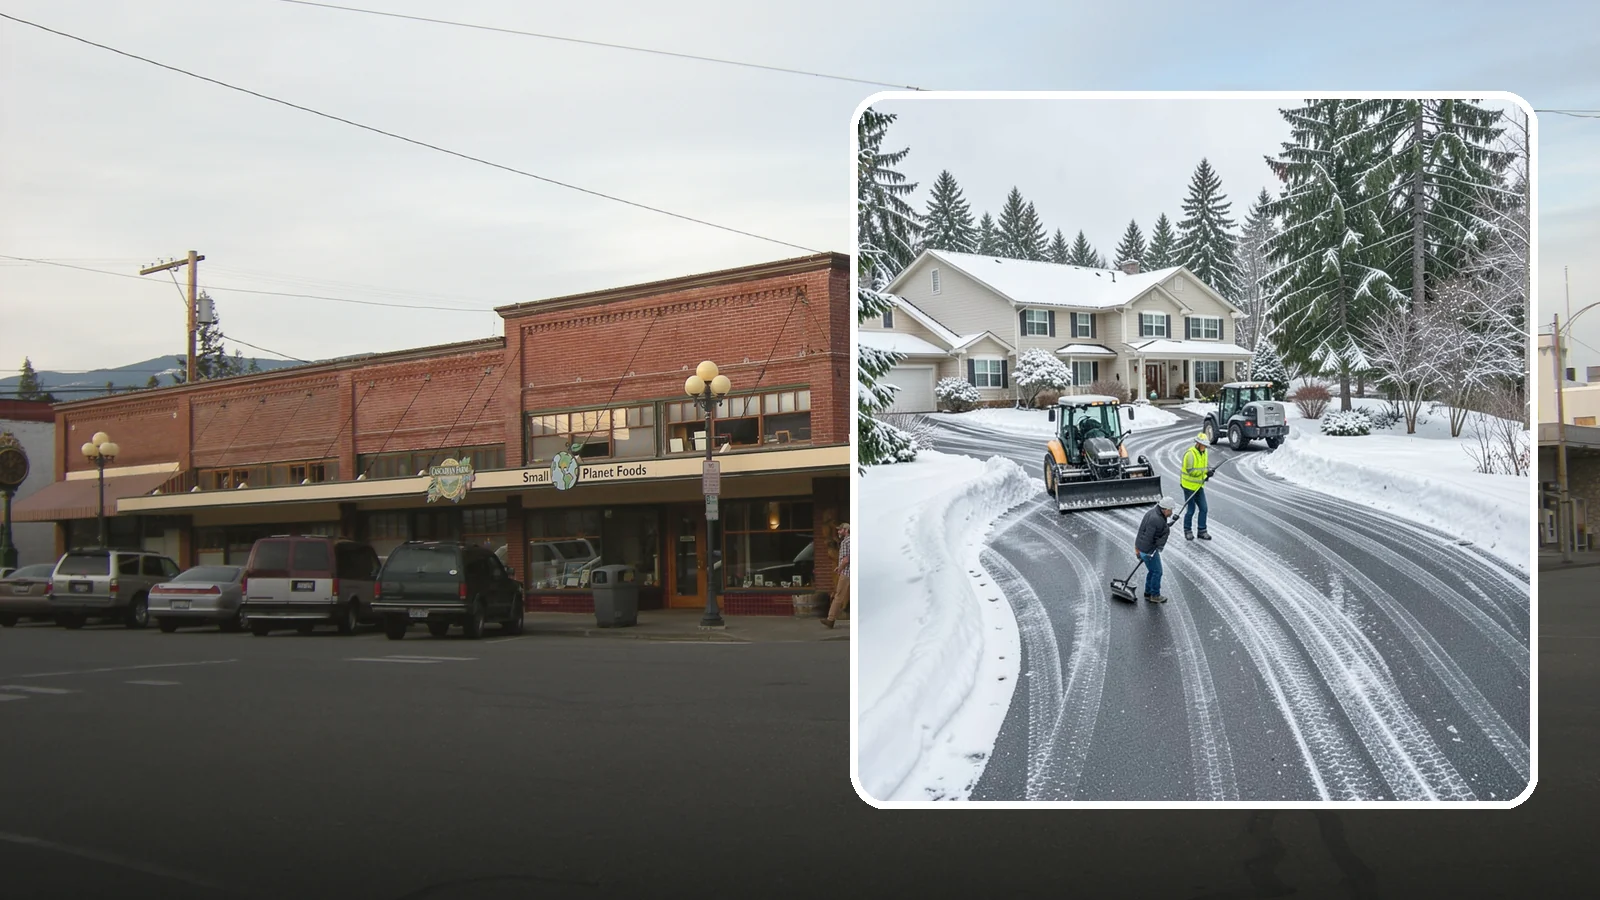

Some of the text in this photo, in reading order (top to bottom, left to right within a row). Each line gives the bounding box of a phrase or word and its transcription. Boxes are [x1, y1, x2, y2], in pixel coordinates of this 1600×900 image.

[523, 464, 647, 483] Small Planet Foods
